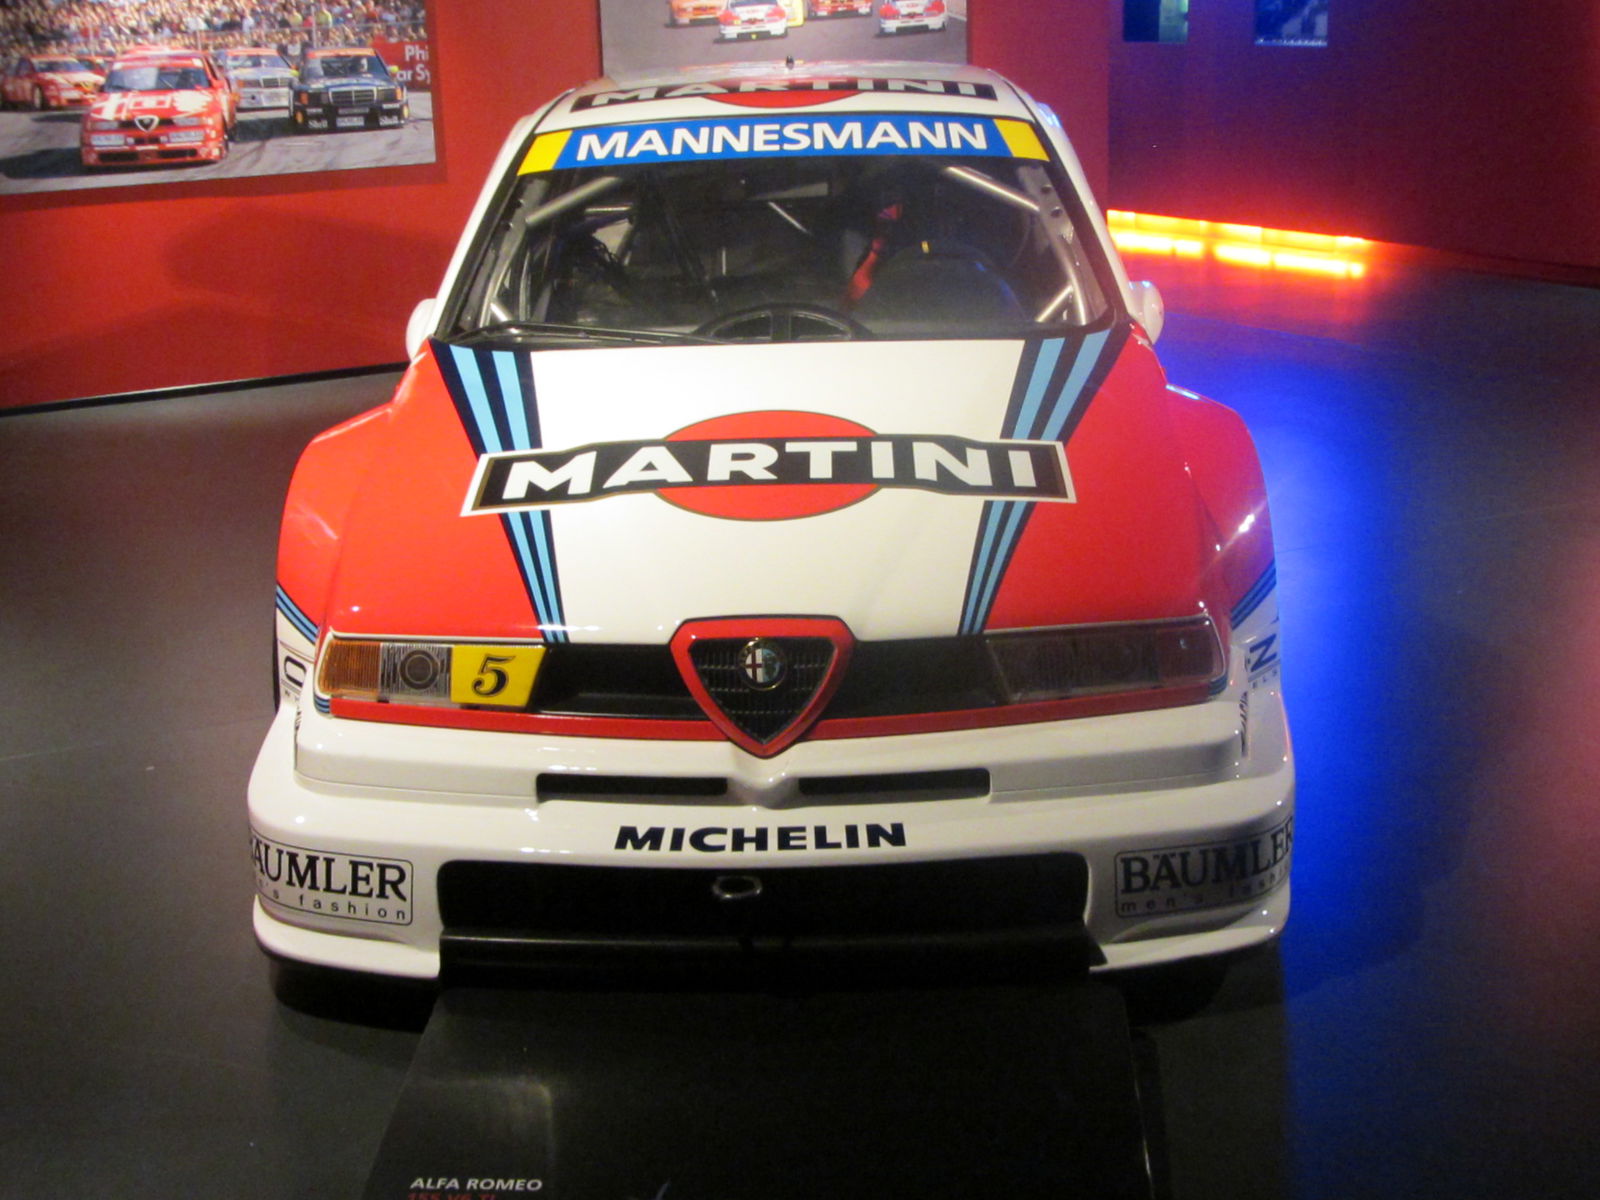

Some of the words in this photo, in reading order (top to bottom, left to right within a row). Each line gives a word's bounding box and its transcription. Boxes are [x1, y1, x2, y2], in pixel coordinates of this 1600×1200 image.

[591, 78, 977, 107] MARTINI
[577, 121, 988, 162] MANNESMANN
[502, 441, 1037, 499] MARTINI
[471, 653, 516, 697] 5
[614, 822, 907, 853] MICHELIN
[298, 893, 406, 921] fashion
[410, 1177, 460, 1190] ALFA
[466, 1178, 543, 1191] ROMEO
